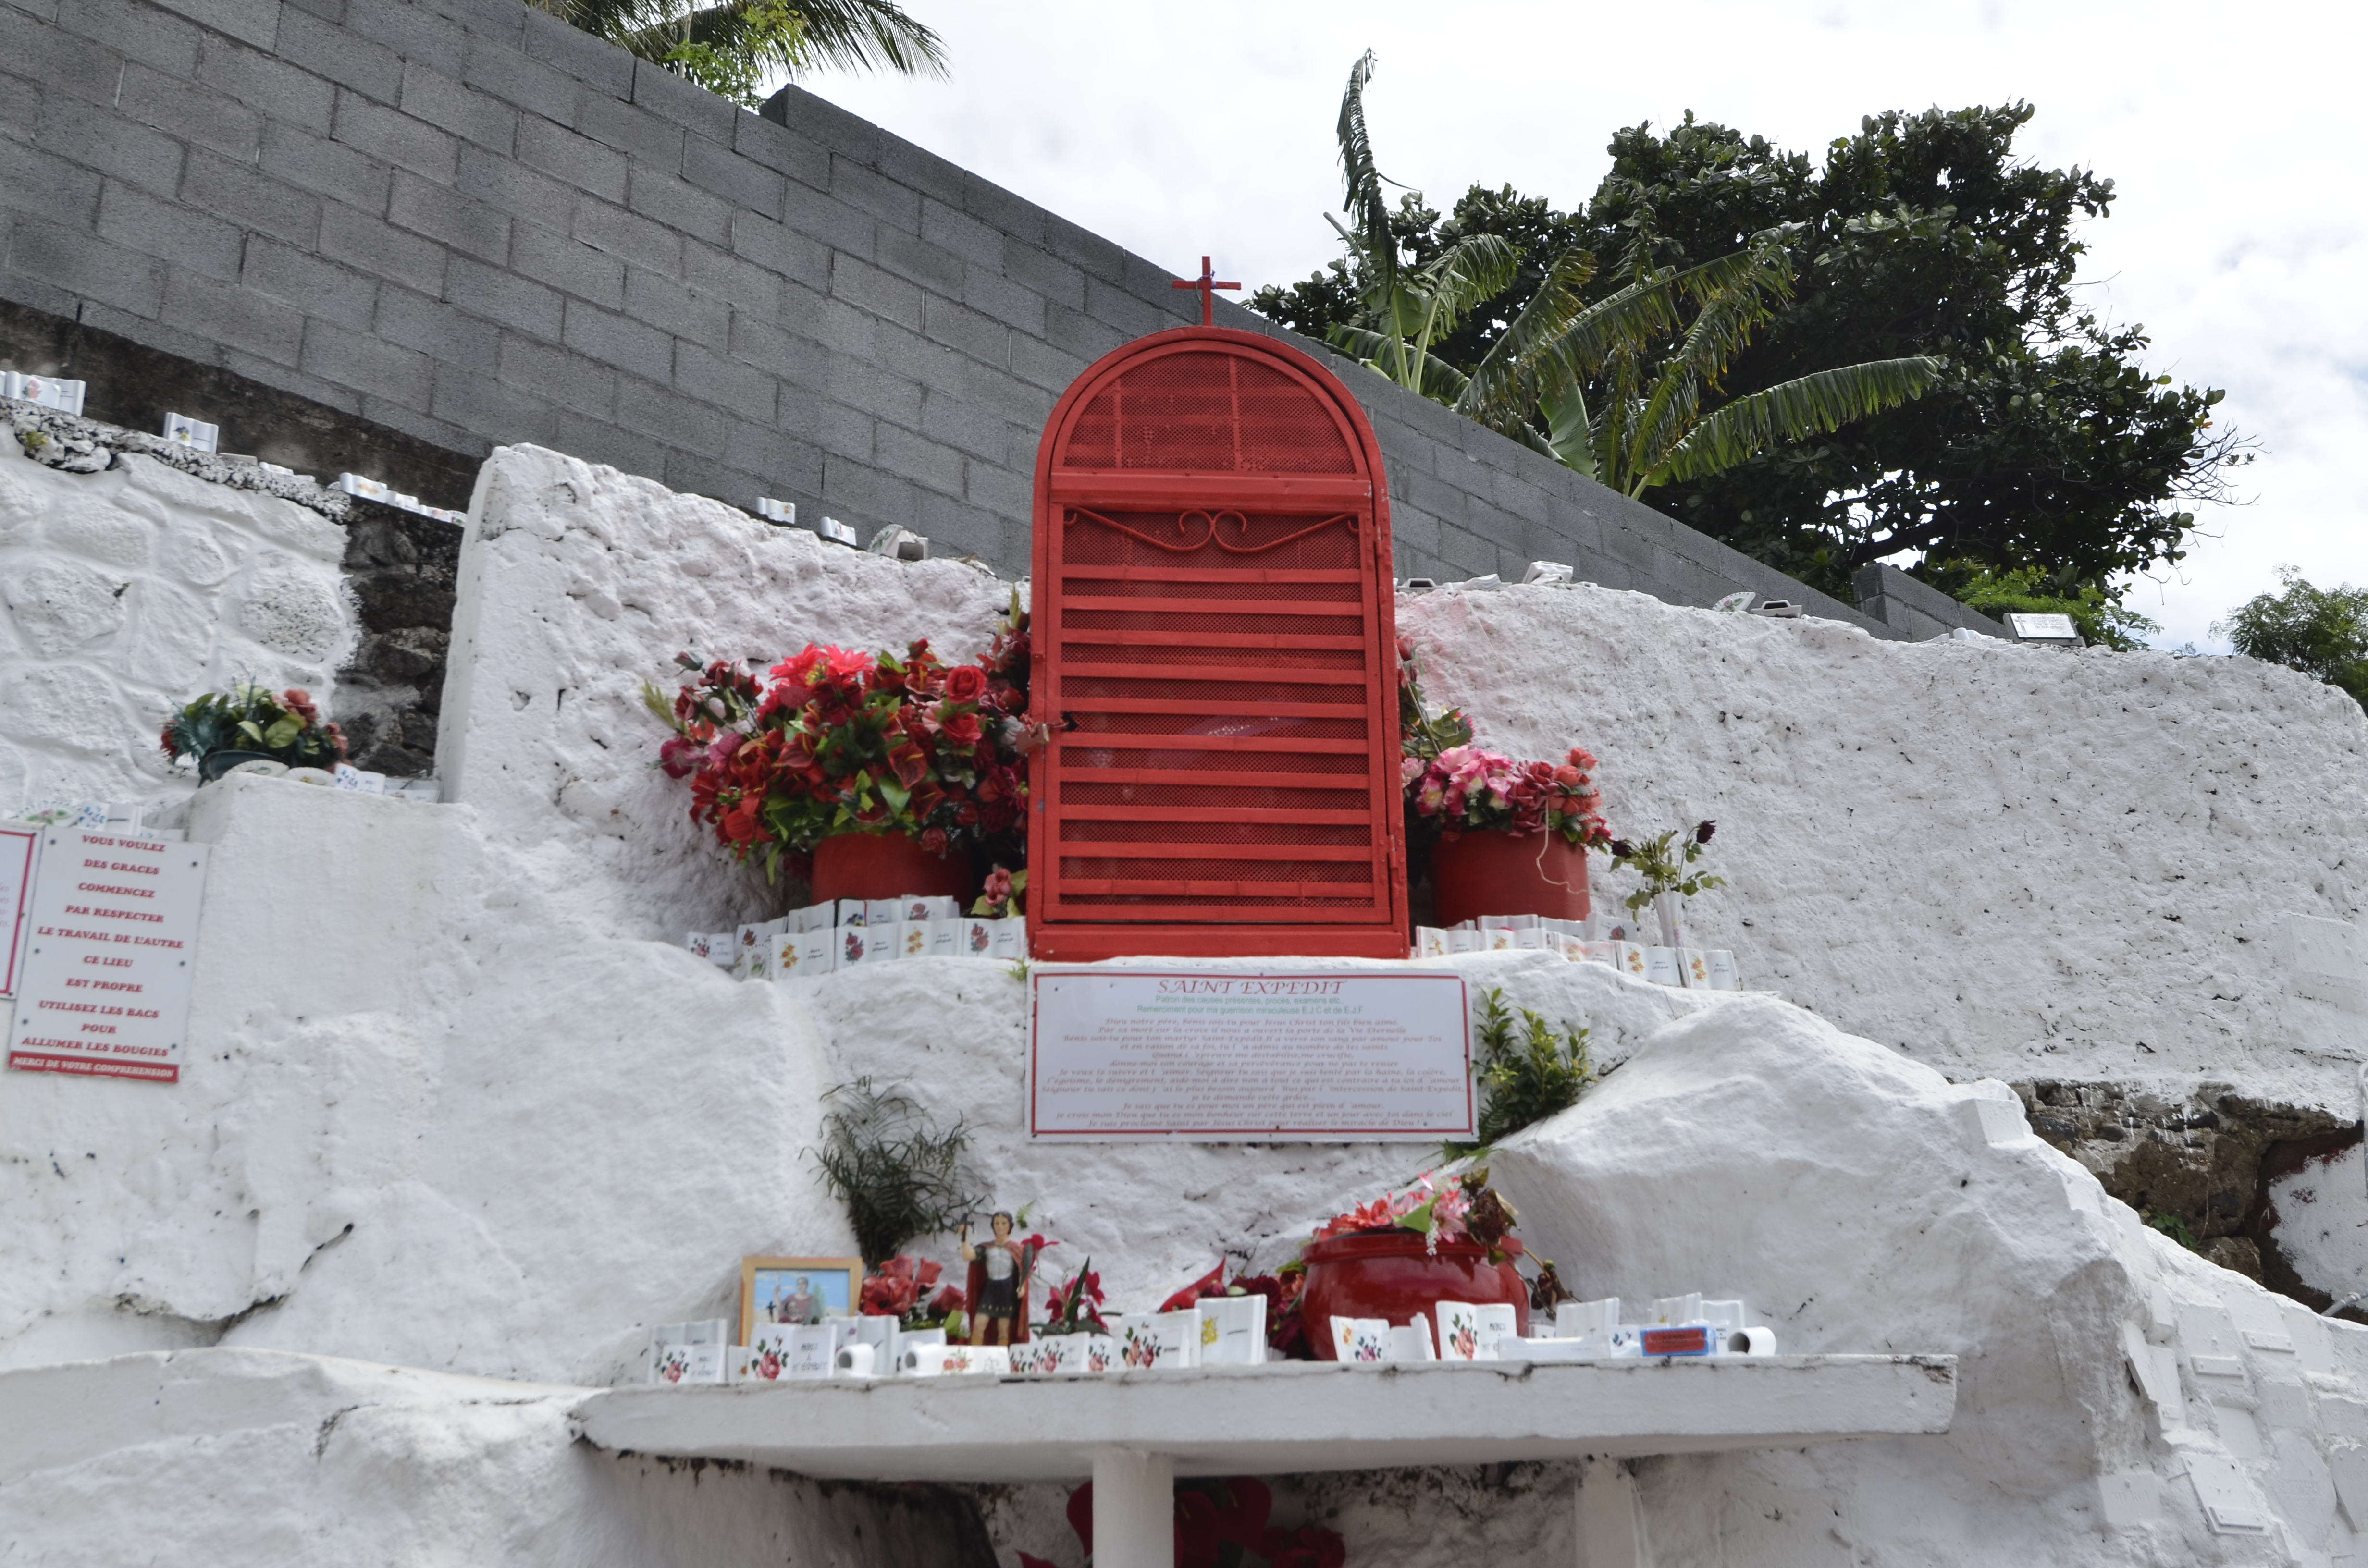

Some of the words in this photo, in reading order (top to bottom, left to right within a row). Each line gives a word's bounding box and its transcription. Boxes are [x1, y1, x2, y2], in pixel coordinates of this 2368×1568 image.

[83, 834, 115, 847] VOUS
[119, 838, 166, 852] VOULEZ
[84, 859, 108, 869] DES
[112, 862, 160, 875] GRACES
[78, 882, 156, 898] COMMENCEZ
[65, 905, 90, 915] PAR
[94, 908, 164, 923] RESPECTER
[38, 926, 54, 936] LE
[58, 928, 111, 942] TRAVAIL
[115, 934, 131, 944] DE
[135, 935, 184, 949] L'AUTRE
[84, 956, 99, 965] CE
[103, 957, 133, 968] LIEU
[66, 978, 90, 988] EST
[94, 980, 143, 992] PROPRE
[1157, 980, 1238, 993] SAINT
[1240, 980, 1348, 994] EXPEDIT
[39, 1000, 97, 1013] UTILISEZ
[101, 1005, 123, 1015] LES
[127, 1007, 160, 1018] BACS
[81, 1023, 117, 1034] POUR
[22, 1037, 83, 1049] ALLUMER
[86, 1042, 109, 1052] LES
[113, 1044, 169, 1057] BOUGIES
[13, 1057, 44, 1067] MERCI
[47, 1060, 60, 1068] DE
[62, 1061, 93, 1071] VOTRE
[94, 1063, 174, 1078] COMPREHENSION
